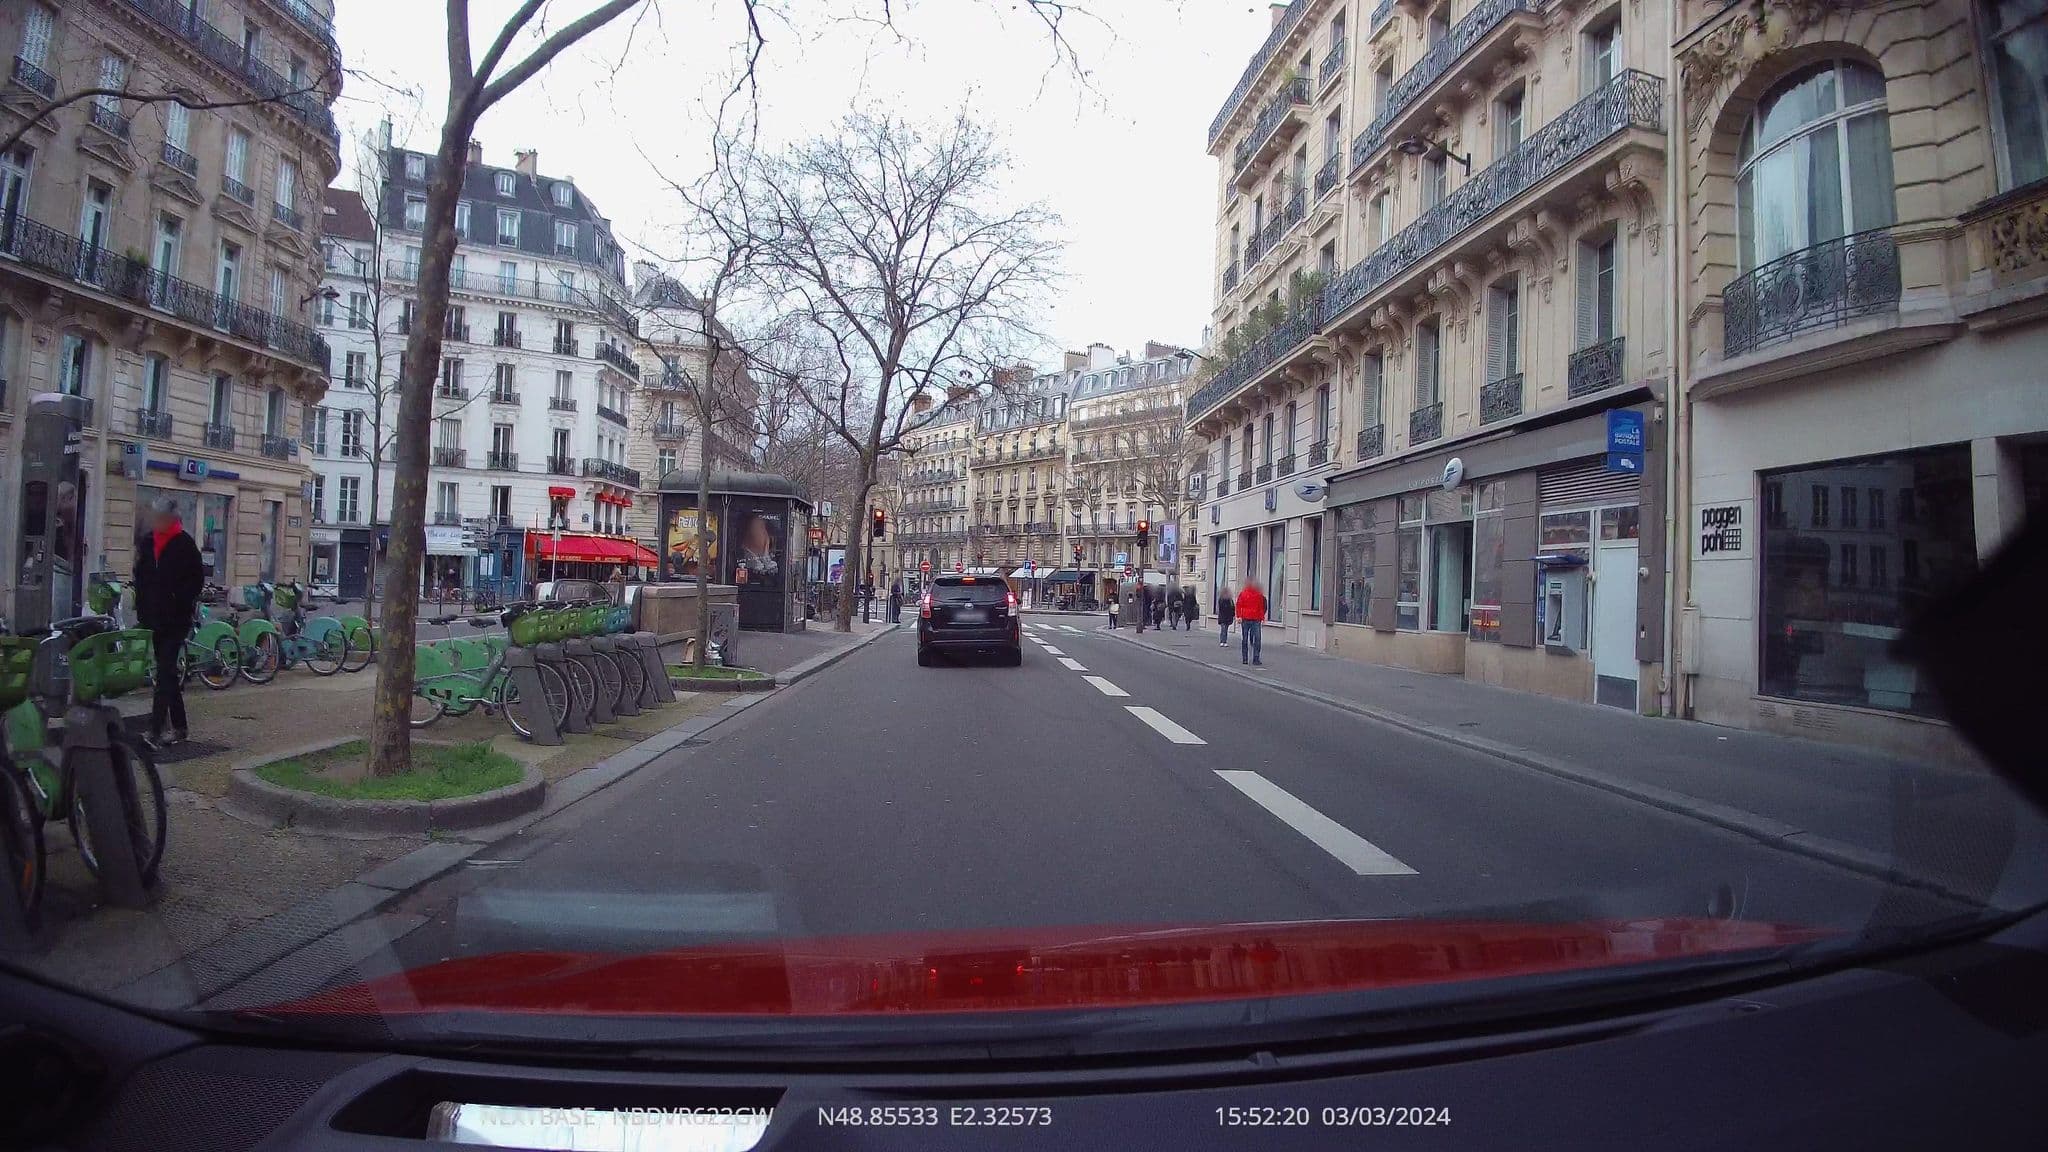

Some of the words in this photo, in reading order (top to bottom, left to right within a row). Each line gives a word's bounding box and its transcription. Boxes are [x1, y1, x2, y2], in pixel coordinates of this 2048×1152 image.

[1614, 438, 1640, 446] POSTALE
[1702, 506, 1742, 530] poggen
[1702, 529, 1725, 555] pohl
